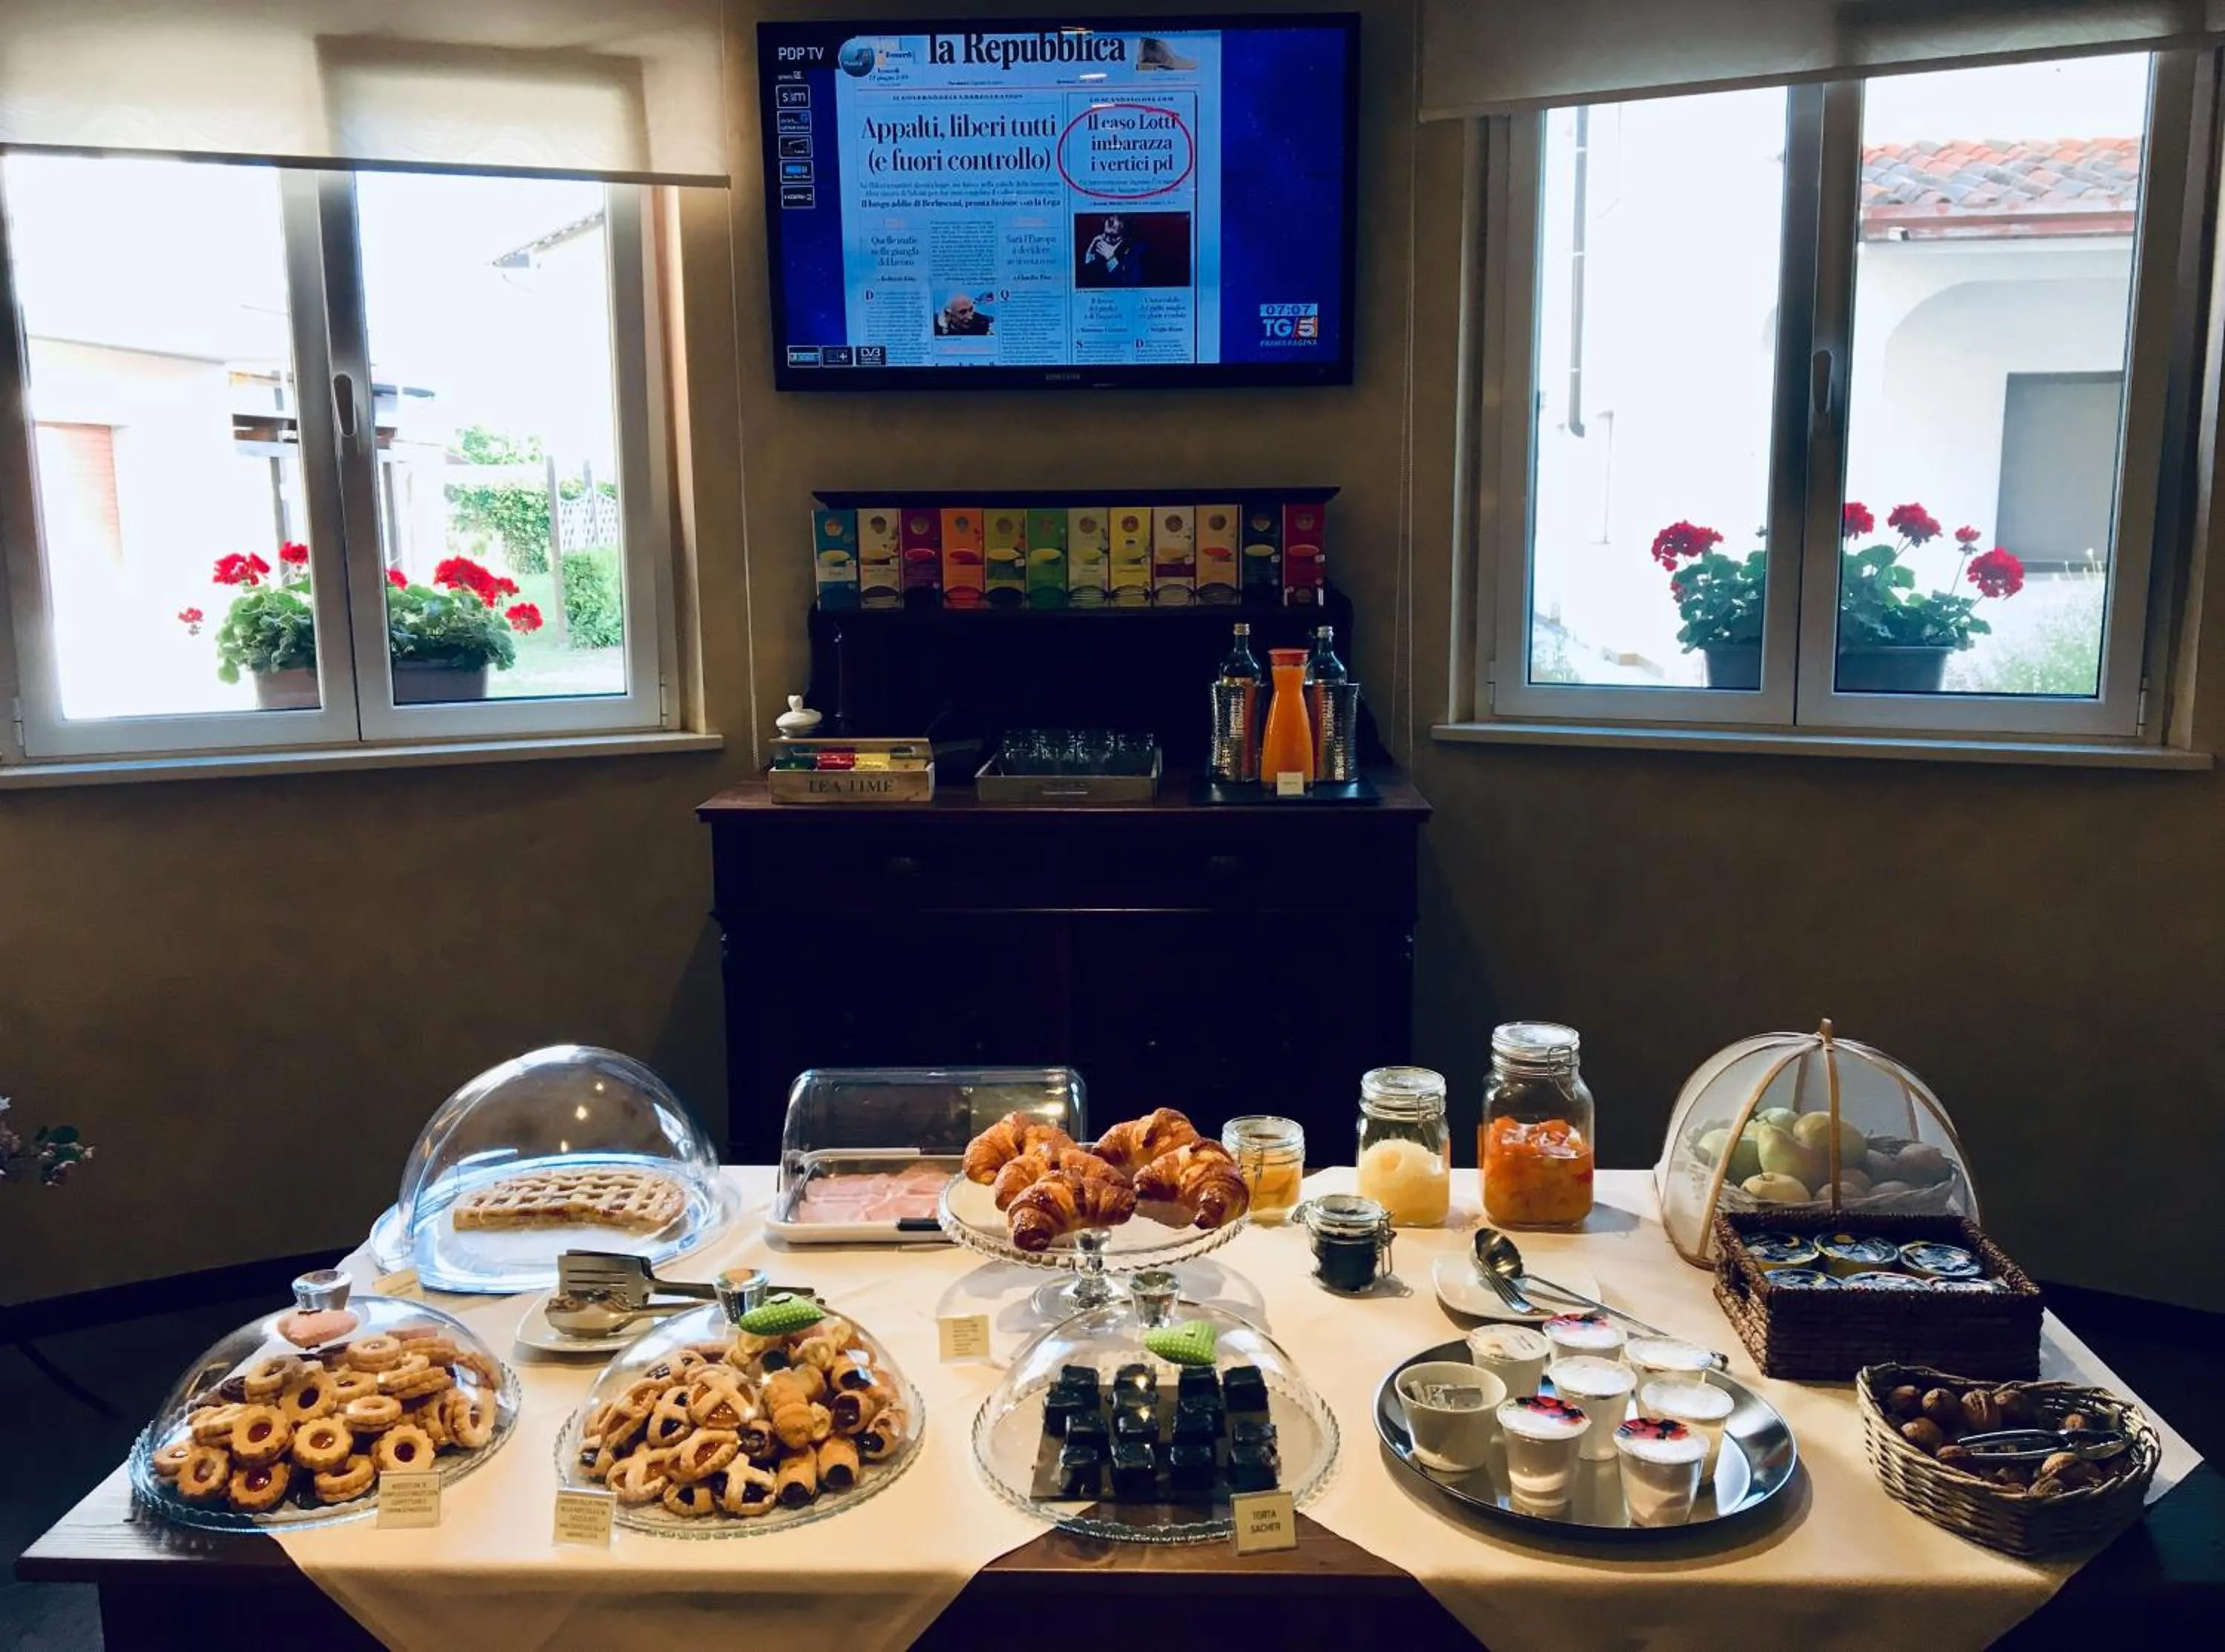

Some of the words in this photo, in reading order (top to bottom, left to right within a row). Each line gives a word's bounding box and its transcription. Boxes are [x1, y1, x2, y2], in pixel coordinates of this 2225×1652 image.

[778, 47, 805, 60] PDP
[806, 47, 824, 60] TV
[928, 34, 955, 64] la
[963, 33, 1126, 70] Repubblica
[861, 114, 946, 144] Appalti,
[950, 113, 1006, 137] liberi
[1011, 113, 1056, 137] tutti
[1087, 113, 1098, 130] Il
[1101, 118, 1135, 130] caso
[1138, 113, 1176, 130] Lotti
[1091, 134, 1173, 151] imbarazza
[868, 148, 888, 175] (e
[892, 148, 943, 171] fuori
[947, 146, 1051, 173] controllo)
[1091, 156, 1095, 171] i
[1099, 155, 1150, 171] vertici
[1153, 154, 1173, 174] pd
[1265, 305, 1311, 315] 07:07
[808, 779, 842, 793] TEA
[847, 780, 893, 793] TIME
[1253, 1510, 1277, 1520] TORTA
[1250, 1522, 1282, 1534] SACHER
